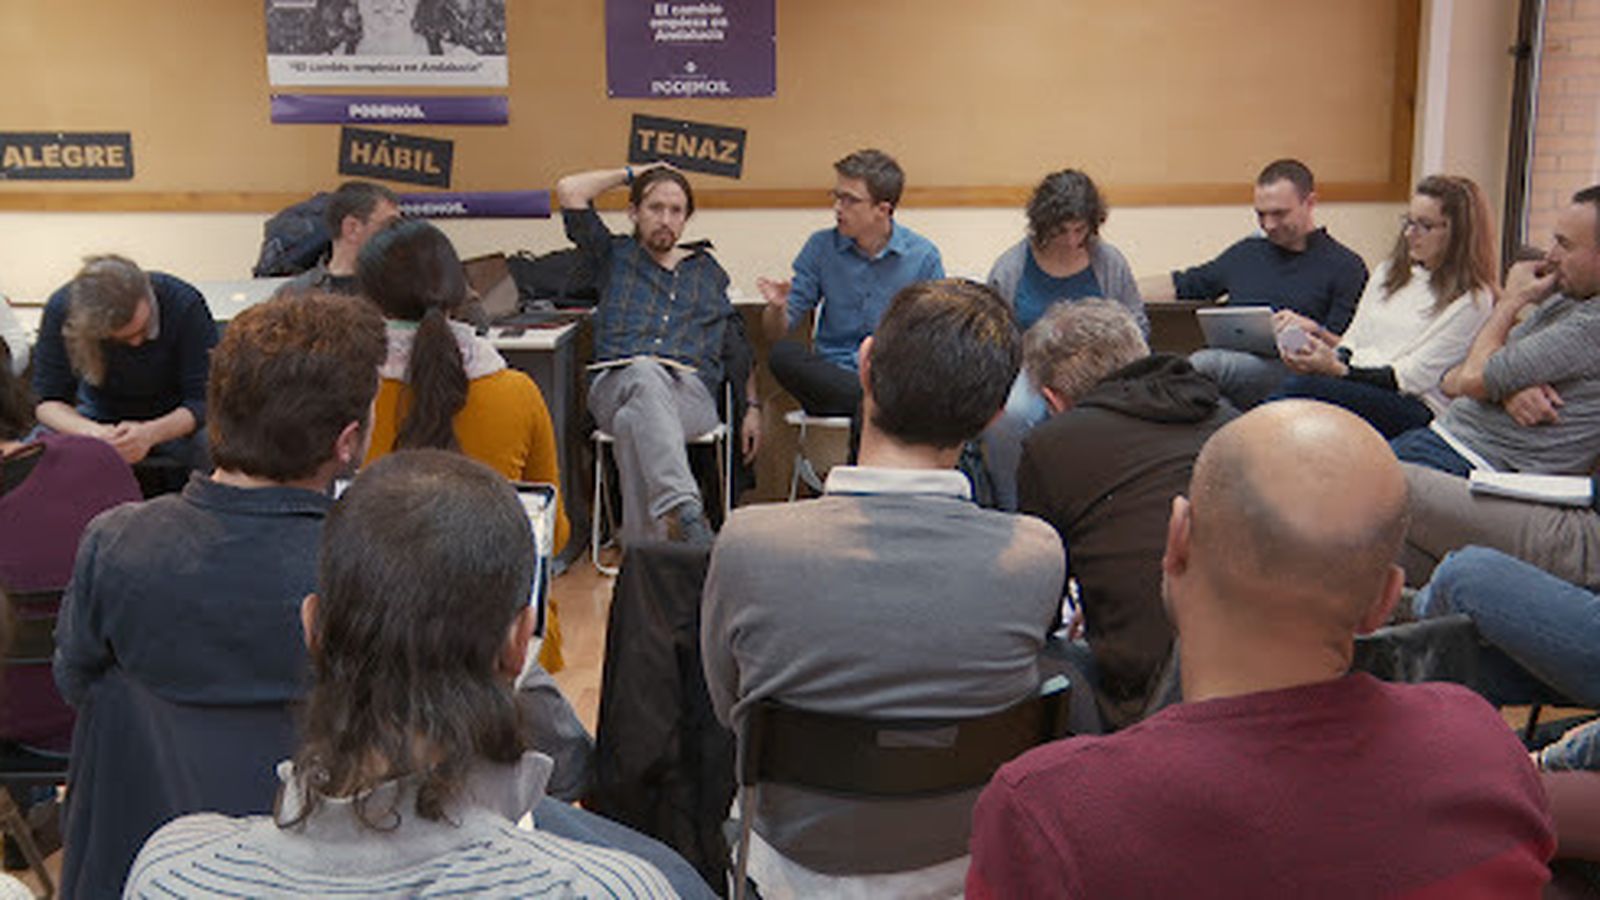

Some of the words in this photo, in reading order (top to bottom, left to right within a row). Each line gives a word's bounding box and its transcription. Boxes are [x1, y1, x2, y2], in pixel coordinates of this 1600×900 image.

[3, 145, 126, 168] ALEGRE
[350, 138, 441, 174] HÁBIL
[637, 128, 740, 165] TENAZ
